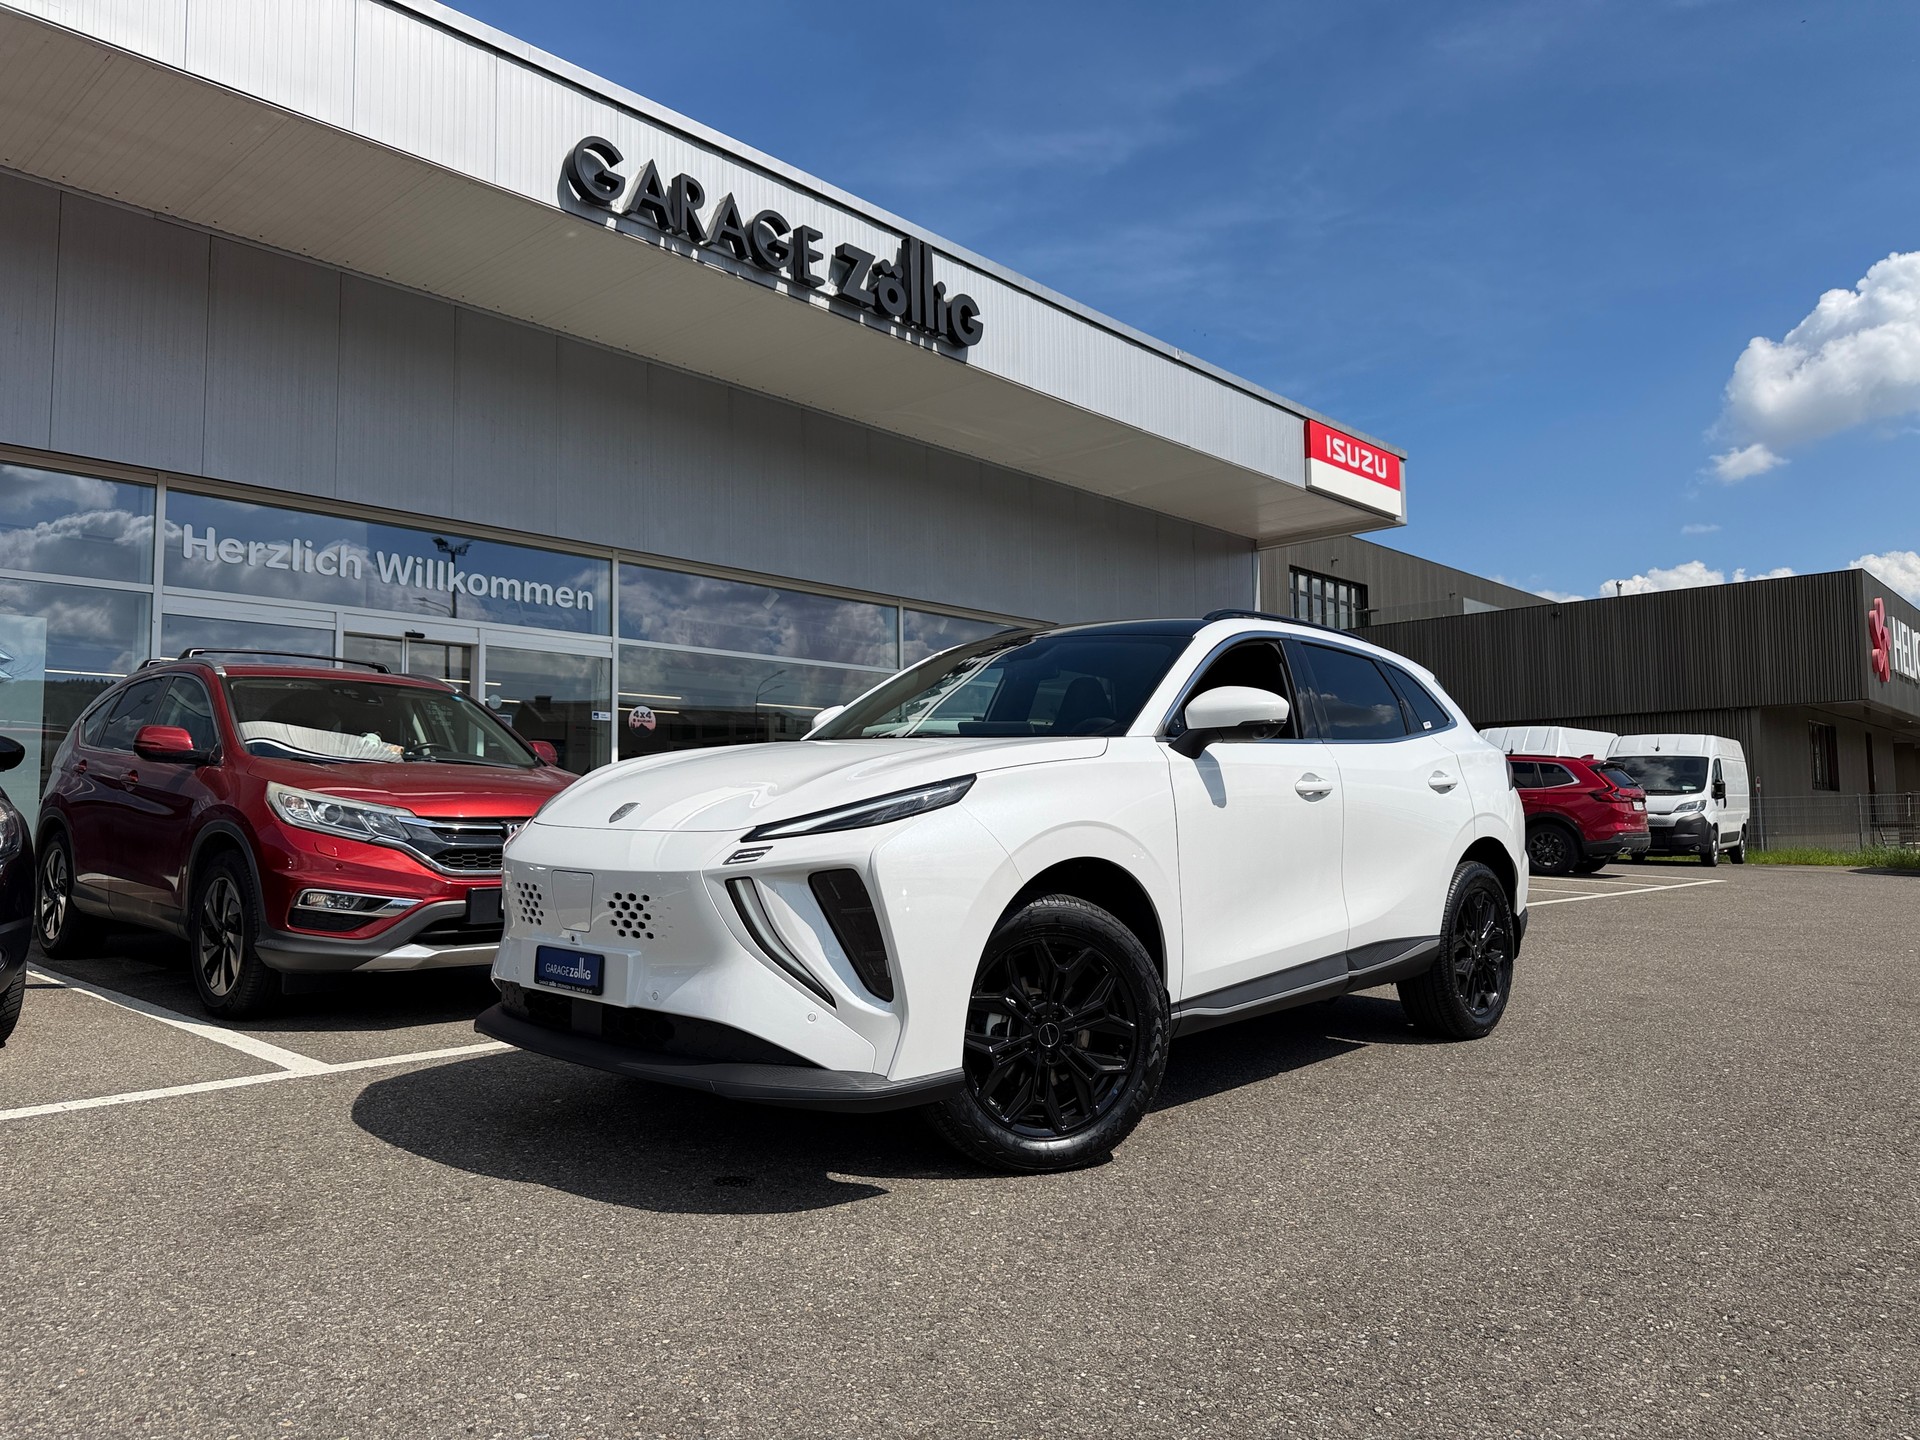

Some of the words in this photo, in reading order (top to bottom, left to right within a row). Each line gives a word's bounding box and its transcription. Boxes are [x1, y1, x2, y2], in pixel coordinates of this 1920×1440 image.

[566, 135, 826, 288] GARAGE
[1325, 434, 1388, 479] ISUZU
[182, 523, 363, 580] Herzlich
[376, 550, 595, 612] Willkommen
[633, 710, 652, 719] 4x4
[545, 963, 569, 976] GARAGE
